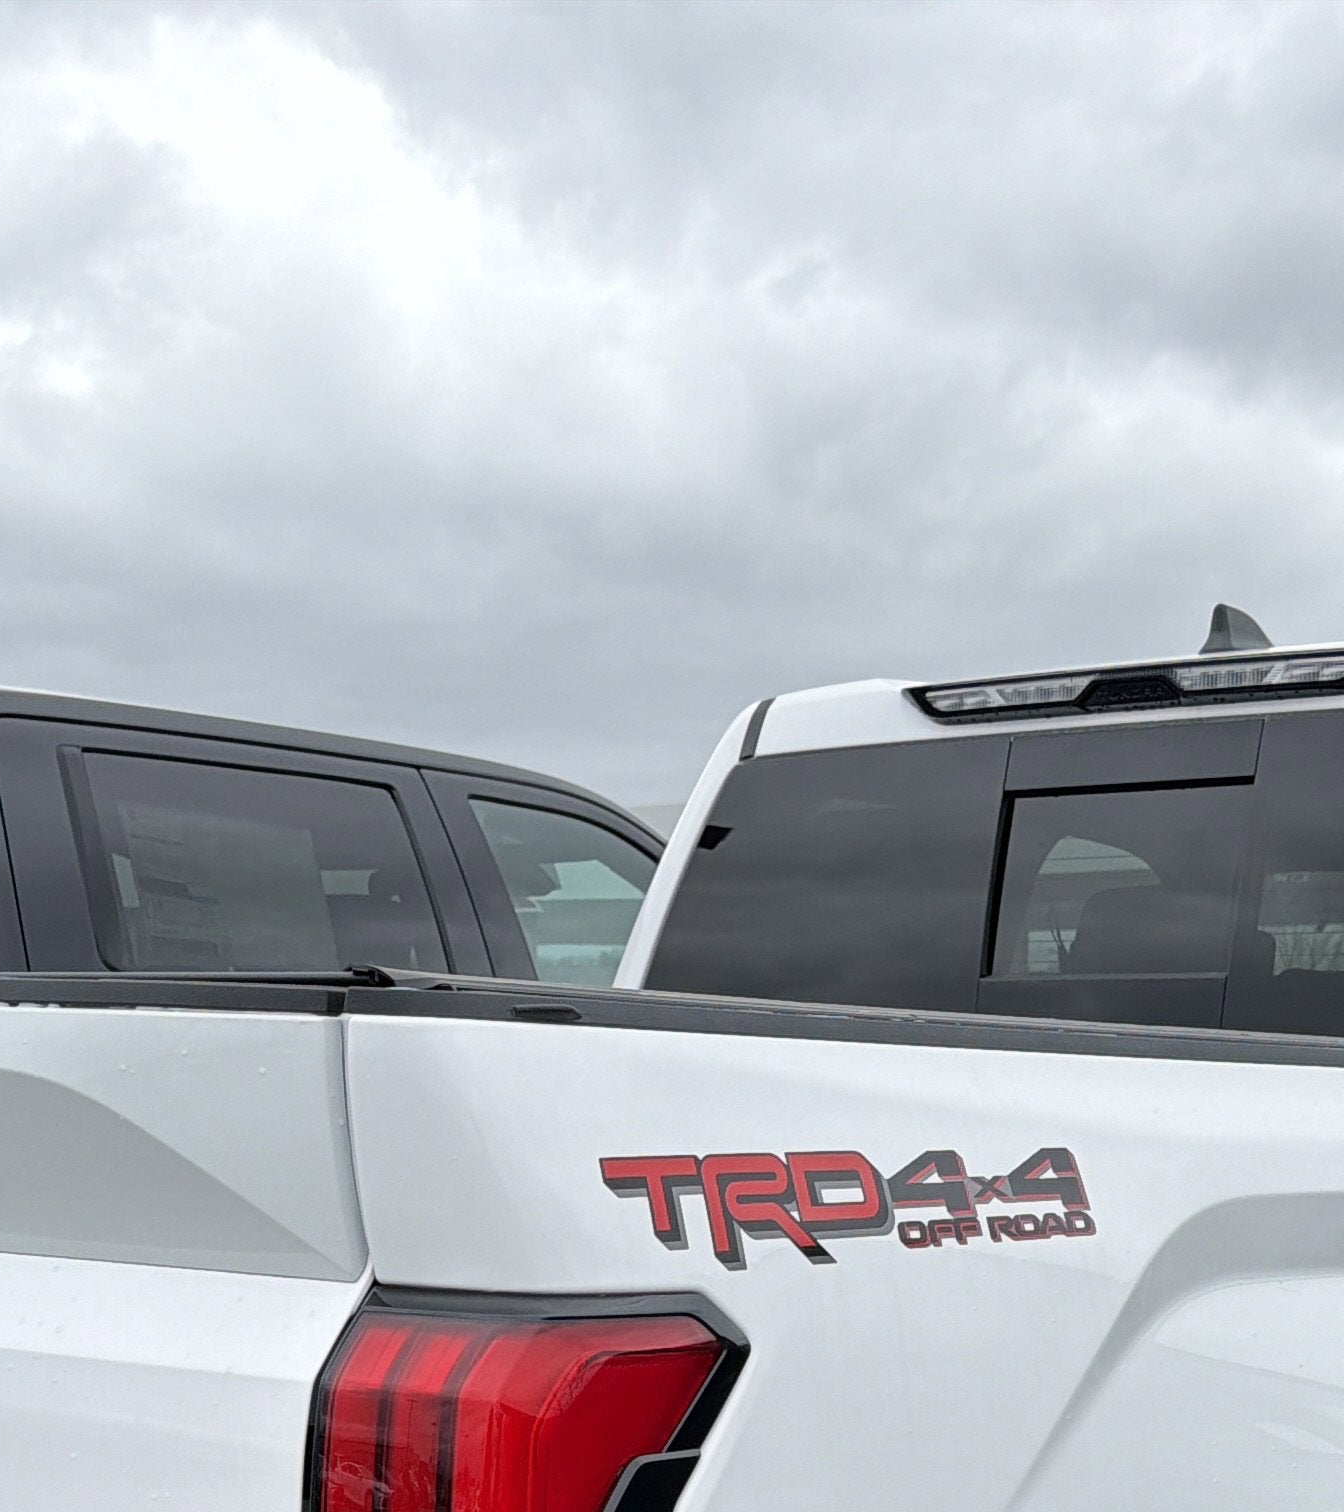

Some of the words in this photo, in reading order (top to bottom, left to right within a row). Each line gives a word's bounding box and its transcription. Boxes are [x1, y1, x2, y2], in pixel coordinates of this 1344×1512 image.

[598, 1150, 896, 1272] TRD
[897, 1215, 984, 1249] OFF
[988, 1210, 1098, 1242] ROAD
